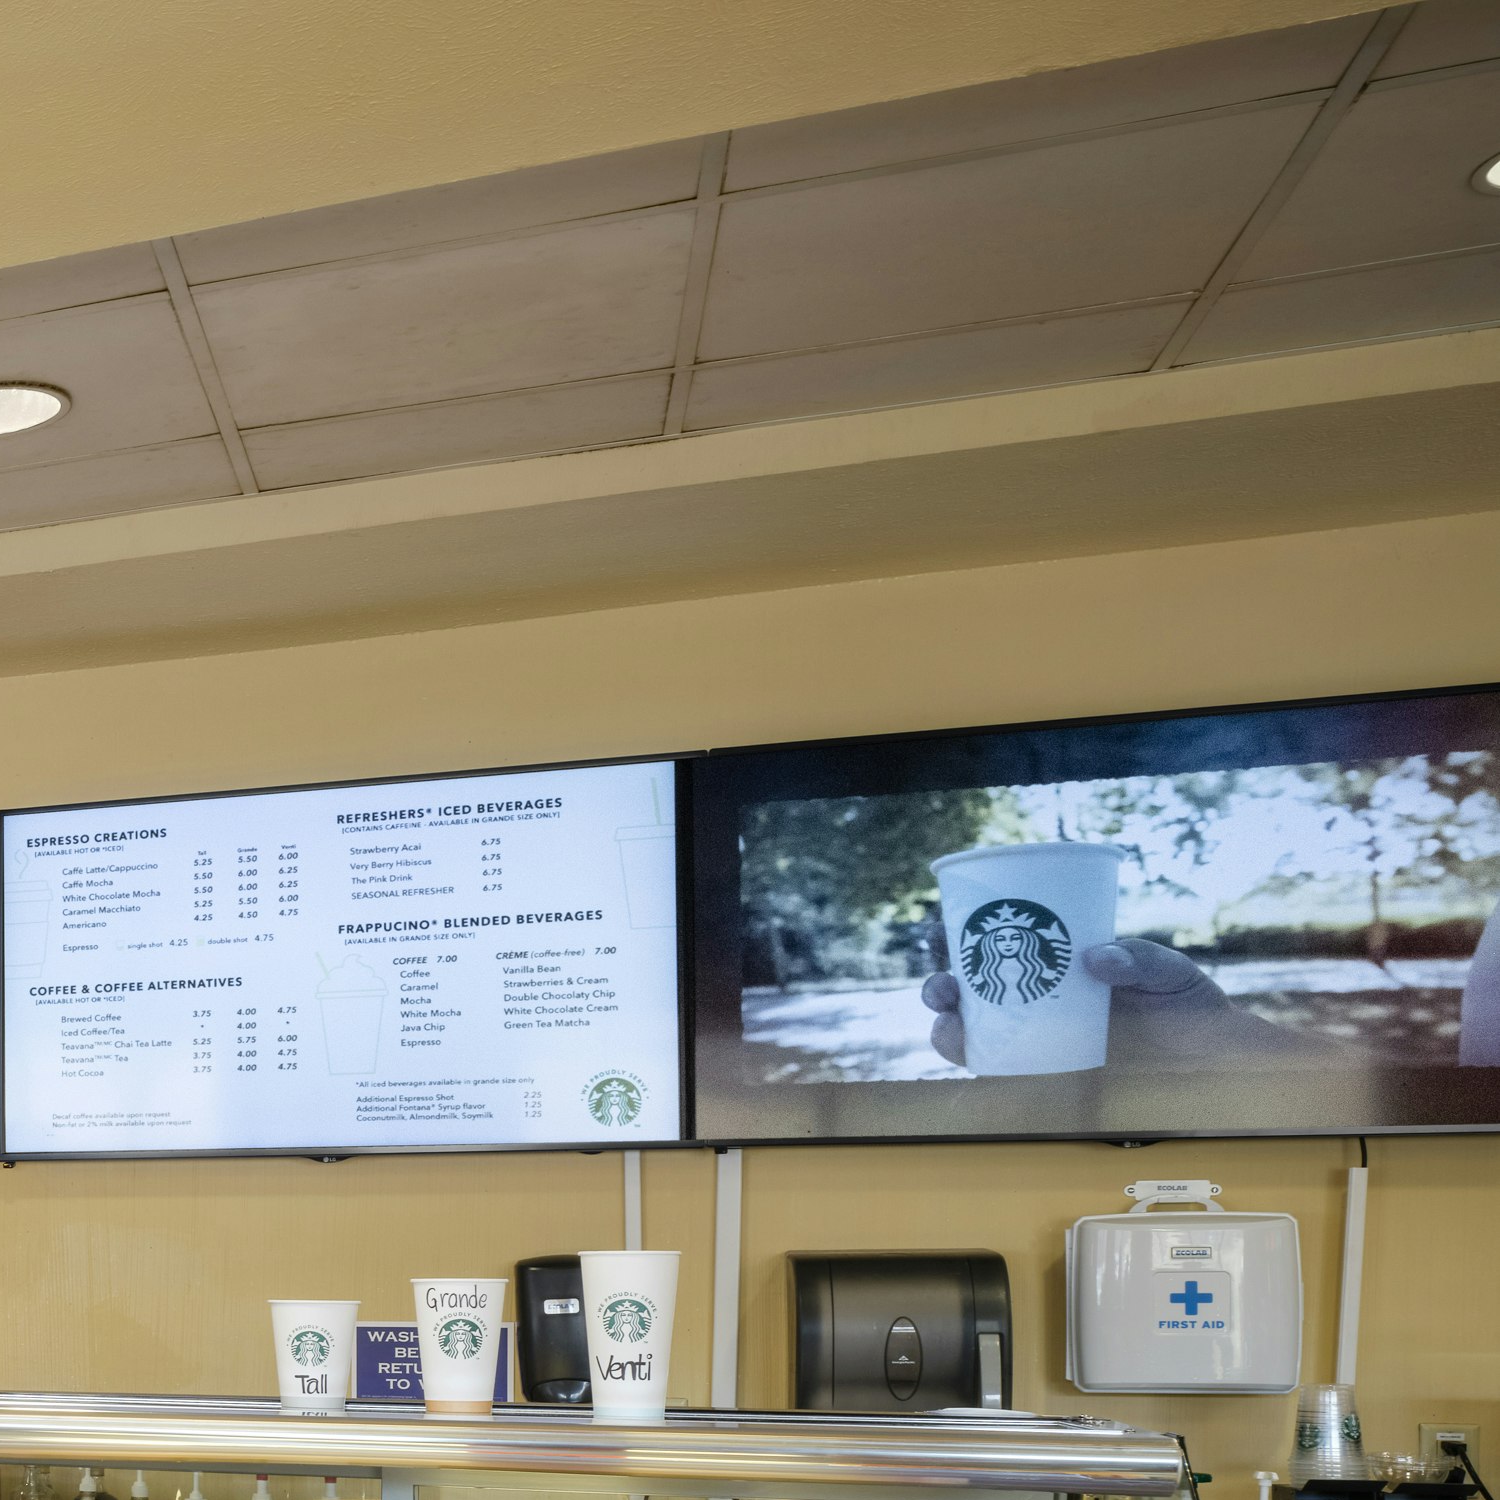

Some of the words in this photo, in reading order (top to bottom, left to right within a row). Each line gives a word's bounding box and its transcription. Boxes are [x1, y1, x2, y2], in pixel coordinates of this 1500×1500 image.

[438, 805, 472, 817] ICED
[477, 798, 563, 814] BEVERAGES
[27, 834, 90, 847] ESPRESSO
[94, 829, 167, 843] CREATIONS
[350, 844, 399, 856] Strawberry
[401, 843, 421, 852] Acai
[481, 838, 501, 847] 6.75
[86, 862, 158, 875] Latte/Cappuccino
[194, 858, 212, 866] 5.25
[238, 855, 257, 863] 5.50
[279, 852, 298, 860] 6.00
[350, 862, 369, 871] Very
[371, 860, 394, 870] Berry
[396, 858, 432, 868] Hibiscus
[481, 854, 501, 862] 6.75
[86, 879, 113, 888] Mocha
[194, 872, 212, 880] 5.50
[238, 869, 257, 877] 6.00
[279, 866, 298, 874] 6.25
[352, 877, 367, 885] The
[369, 875, 387, 883] Pink
[390, 874, 413, 882] Drink
[62, 894, 86, 902] White
[90, 891, 130, 900] Chocolate
[133, 889, 160, 898] Mocha
[351, 890, 400, 900] SEASONAL
[402, 887, 454, 896] REFRESHER
[62, 907, 97, 916] Caramel
[99, 904, 141, 914] Macchiato
[62, 921, 107, 930] Americano
[444, 915, 511, 929] BLENDED
[516, 910, 603, 924] BEVERAGES
[393, 956, 427, 965] COFFEE
[437, 955, 457, 963] 7.00
[503, 966, 535, 975] Vanilla
[537, 964, 561, 973] Bean
[29, 985, 77, 996] COFFEE
[81, 984, 90, 994] &
[94, 982, 144, 993] COFFEE
[148, 977, 243, 991] ALTERNATIVES
[400, 982, 439, 992] Caramel
[61, 1015, 92, 1023] Brewed
[95, 1014, 122, 1022] Coffee
[504, 1020, 533, 1029] Green
[536, 1020, 552, 1028] Tea
[555, 1019, 590, 1027] Matcha
[401, 1023, 421, 1032] Java
[424, 1023, 445, 1032] Chip
[61, 1070, 76, 1078] Hot
[78, 1069, 104, 1077] Cocoa
[426, 1285, 488, 1312] Grande
[605, 1292, 638, 1302] PROUDLY
[641, 1296, 657, 1312] SERVE
[440, 1312, 471, 1323] PROUDLY
[472, 1314, 488, 1332] SERVE
[1159, 1321, 1197, 1329] FIRST
[1202, 1321, 1225, 1329] AID
[367, 1331, 419, 1342] WASH
[596, 1354, 653, 1381] Venti
[295, 1374, 328, 1394] Tall
[386, 1379, 411, 1390] TO
